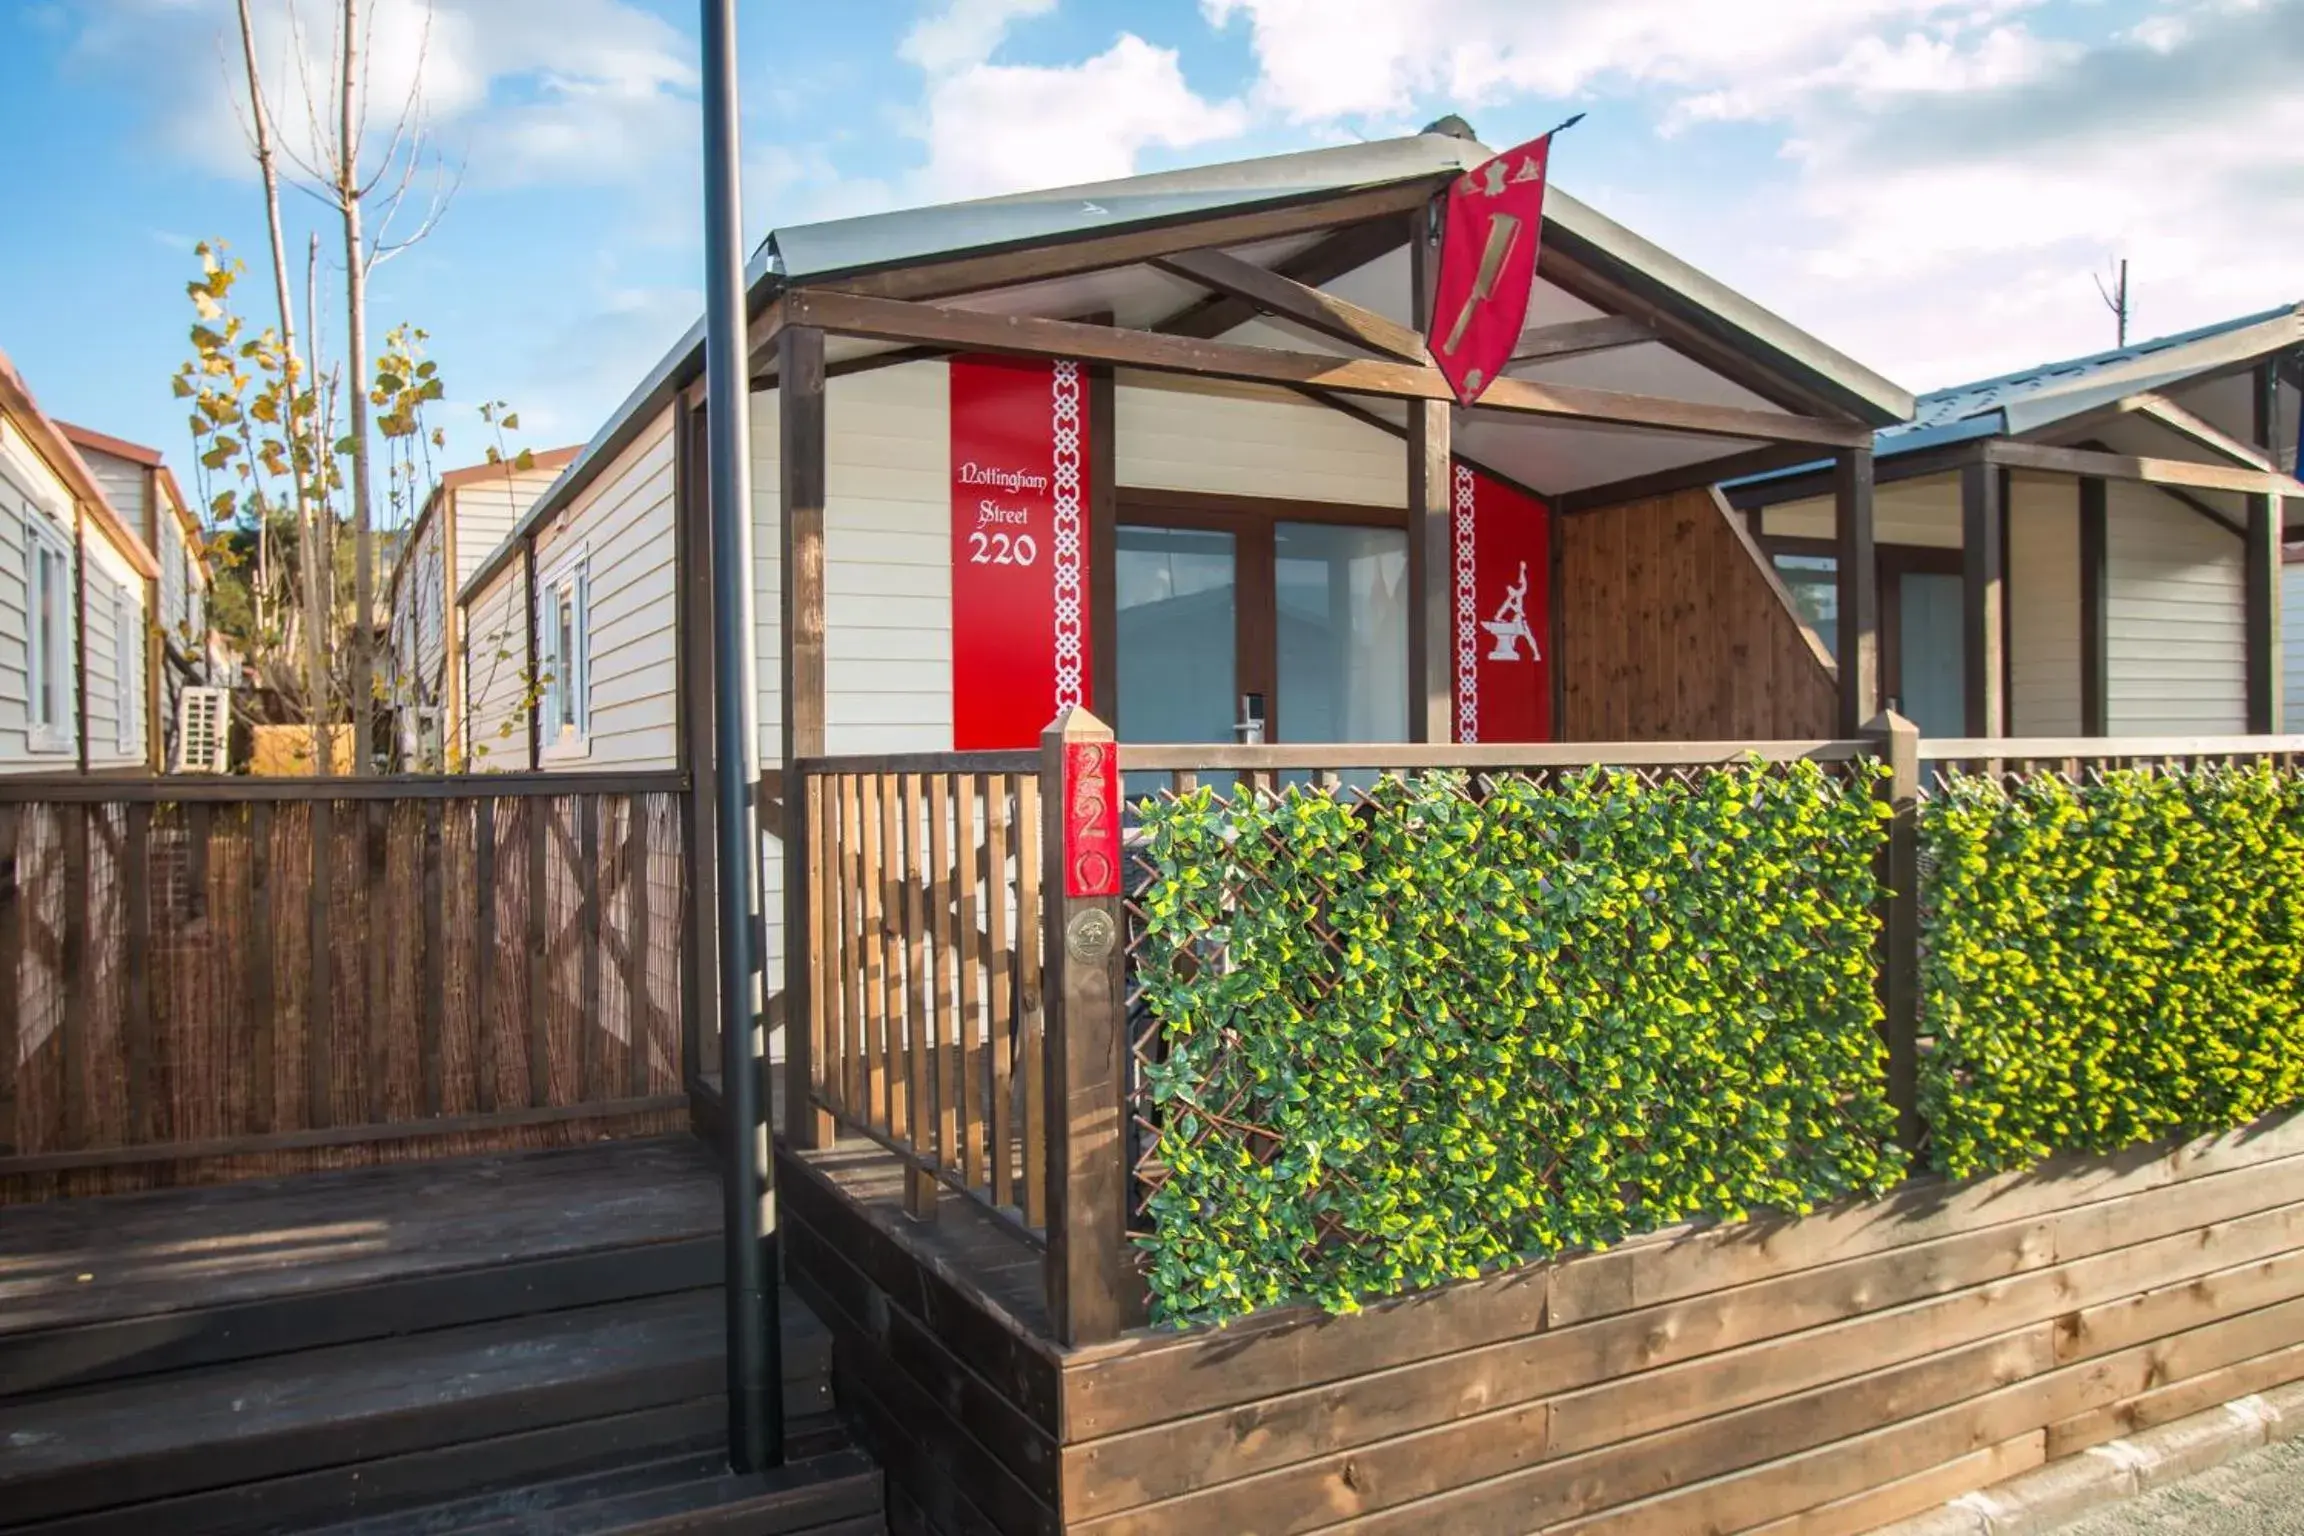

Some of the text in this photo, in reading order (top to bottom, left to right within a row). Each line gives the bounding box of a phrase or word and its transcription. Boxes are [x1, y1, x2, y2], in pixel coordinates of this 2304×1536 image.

[958, 461, 1048, 496] Nottingham
[976, 499, 1028, 529] Street
[968, 531, 1037, 566] 220
[1075, 744, 1111, 892] 220
